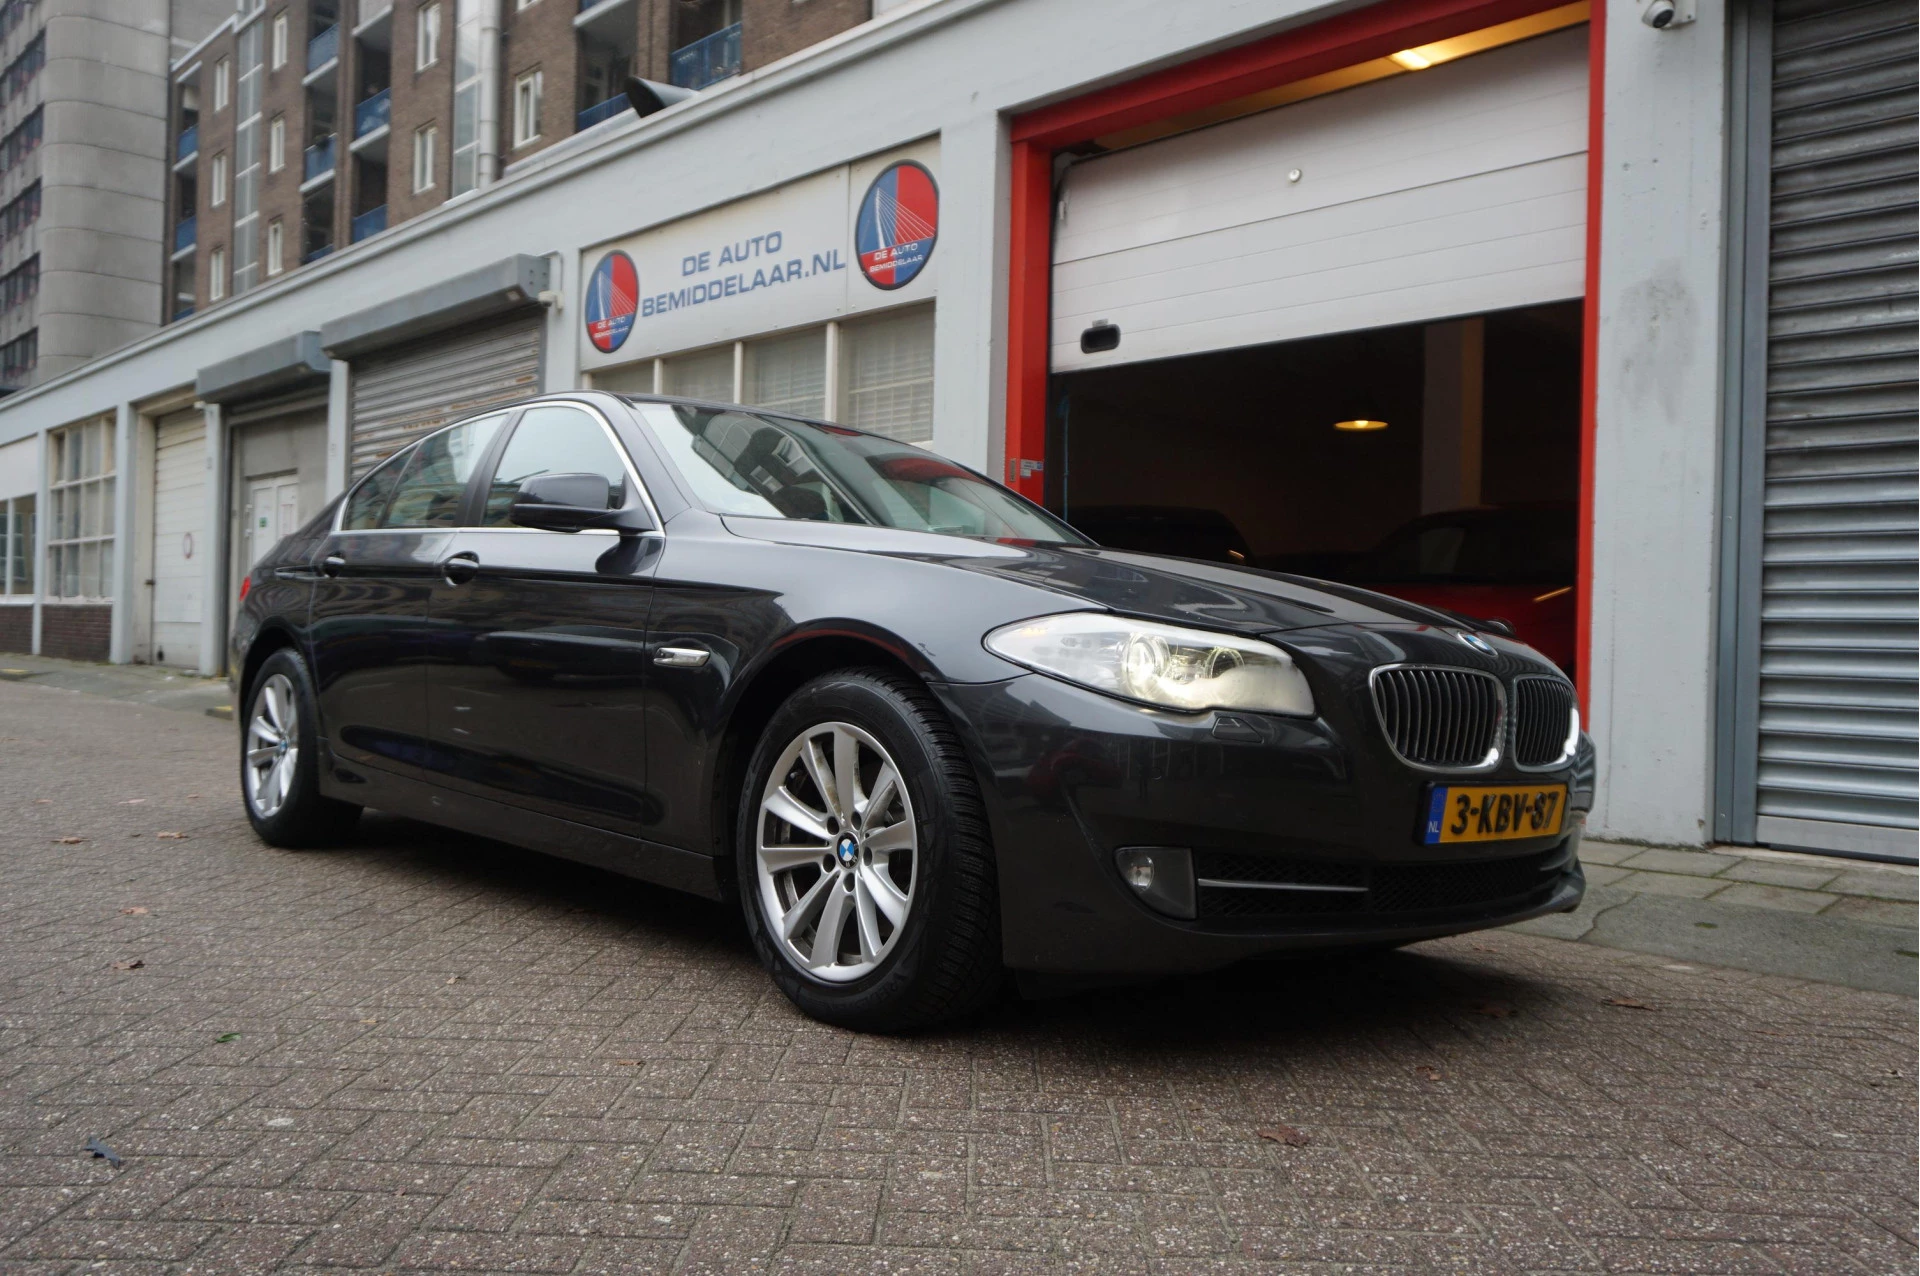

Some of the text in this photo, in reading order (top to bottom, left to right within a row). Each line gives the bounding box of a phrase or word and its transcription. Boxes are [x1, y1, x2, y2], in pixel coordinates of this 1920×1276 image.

[682, 231, 783, 277] DE AUTO
[870, 254, 923, 273] BEMIDDELAAR
[874, 243, 918, 261] DE AUTO
[642, 249, 846, 317] BEMIDDELAAR.NL
[1428, 820, 1439, 833] NL
[1451, 791, 1560, 835] 3-KBV-87
